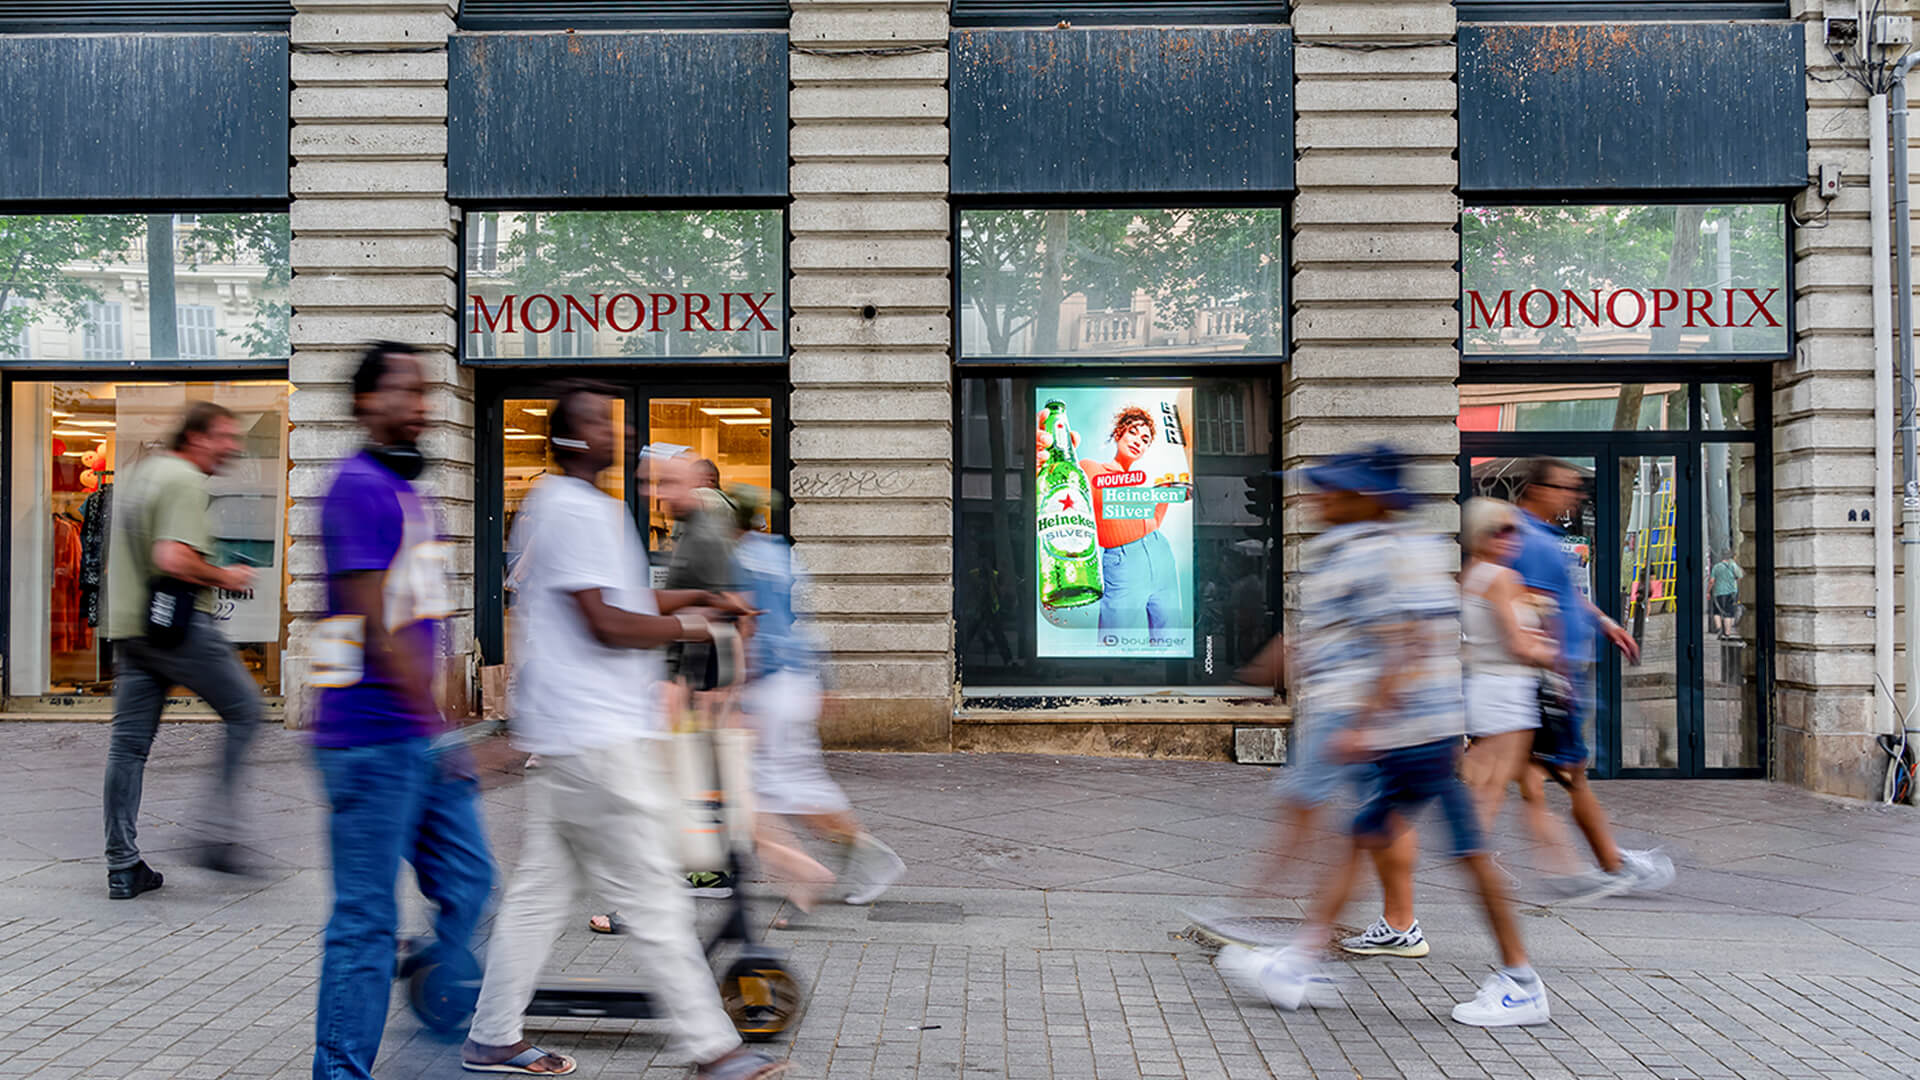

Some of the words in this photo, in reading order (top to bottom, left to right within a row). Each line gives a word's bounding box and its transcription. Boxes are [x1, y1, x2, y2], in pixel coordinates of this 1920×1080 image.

[469, 292, 779, 333] MONOPRIX
[1464, 288, 1783, 329] MONOPRIX
[1096, 471, 1143, 487] NOUVEAU
[1105, 489, 1180, 501] Heineken
[1105, 505, 1152, 517] Silver
